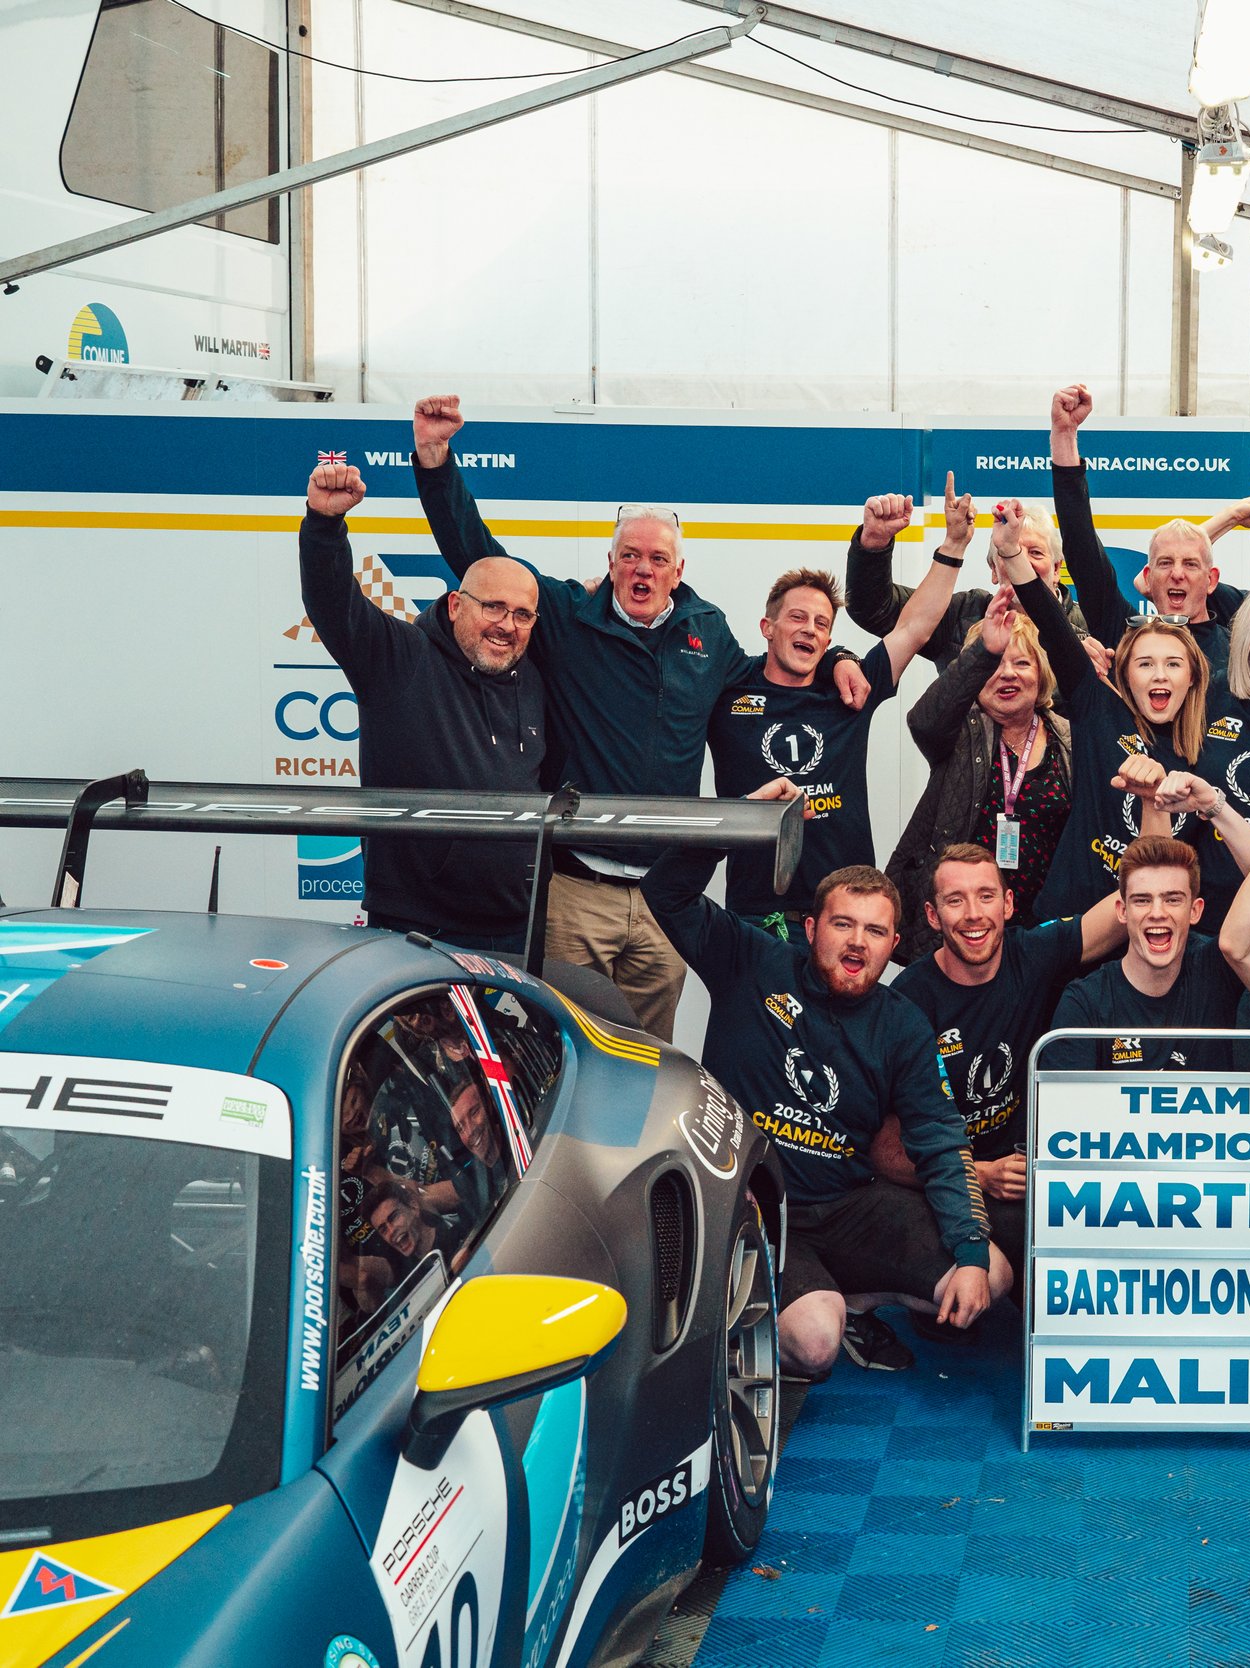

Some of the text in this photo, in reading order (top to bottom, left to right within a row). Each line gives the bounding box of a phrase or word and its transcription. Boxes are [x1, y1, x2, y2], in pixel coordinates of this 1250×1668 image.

[84, 345, 125, 364] COMLINE
[194, 335, 258, 358] WILL MARTIN
[365, 451, 413, 466] WIL
[1208, 727, 1240, 740] COMLINE
[785, 735, 800, 762] 1
[275, 757, 360, 777] RICHA
[301, 878, 363, 896] procee
[940, 1042, 964, 1055] MLINE
[1112, 1050, 1143, 1061] OMLINE
[1120, 1086, 1250, 1115] TEAM
[692, 1094, 734, 1155] Lining
[773, 1103, 812, 1126] 2022
[775, 1137, 798, 1151] Porsche
[799, 1146, 821, 1156] Carrera
[821, 1151, 833, 1160] Cup
[301, 1165, 327, 1391] www.porsche.co.uk
[621, 1471, 687, 1538] BOSS
[382, 1477, 453, 1576] PORSCHE
[400, 1544, 441, 1608] CARRERA CUP
[408, 1561, 450, 1627] GREAT BRITAIN
